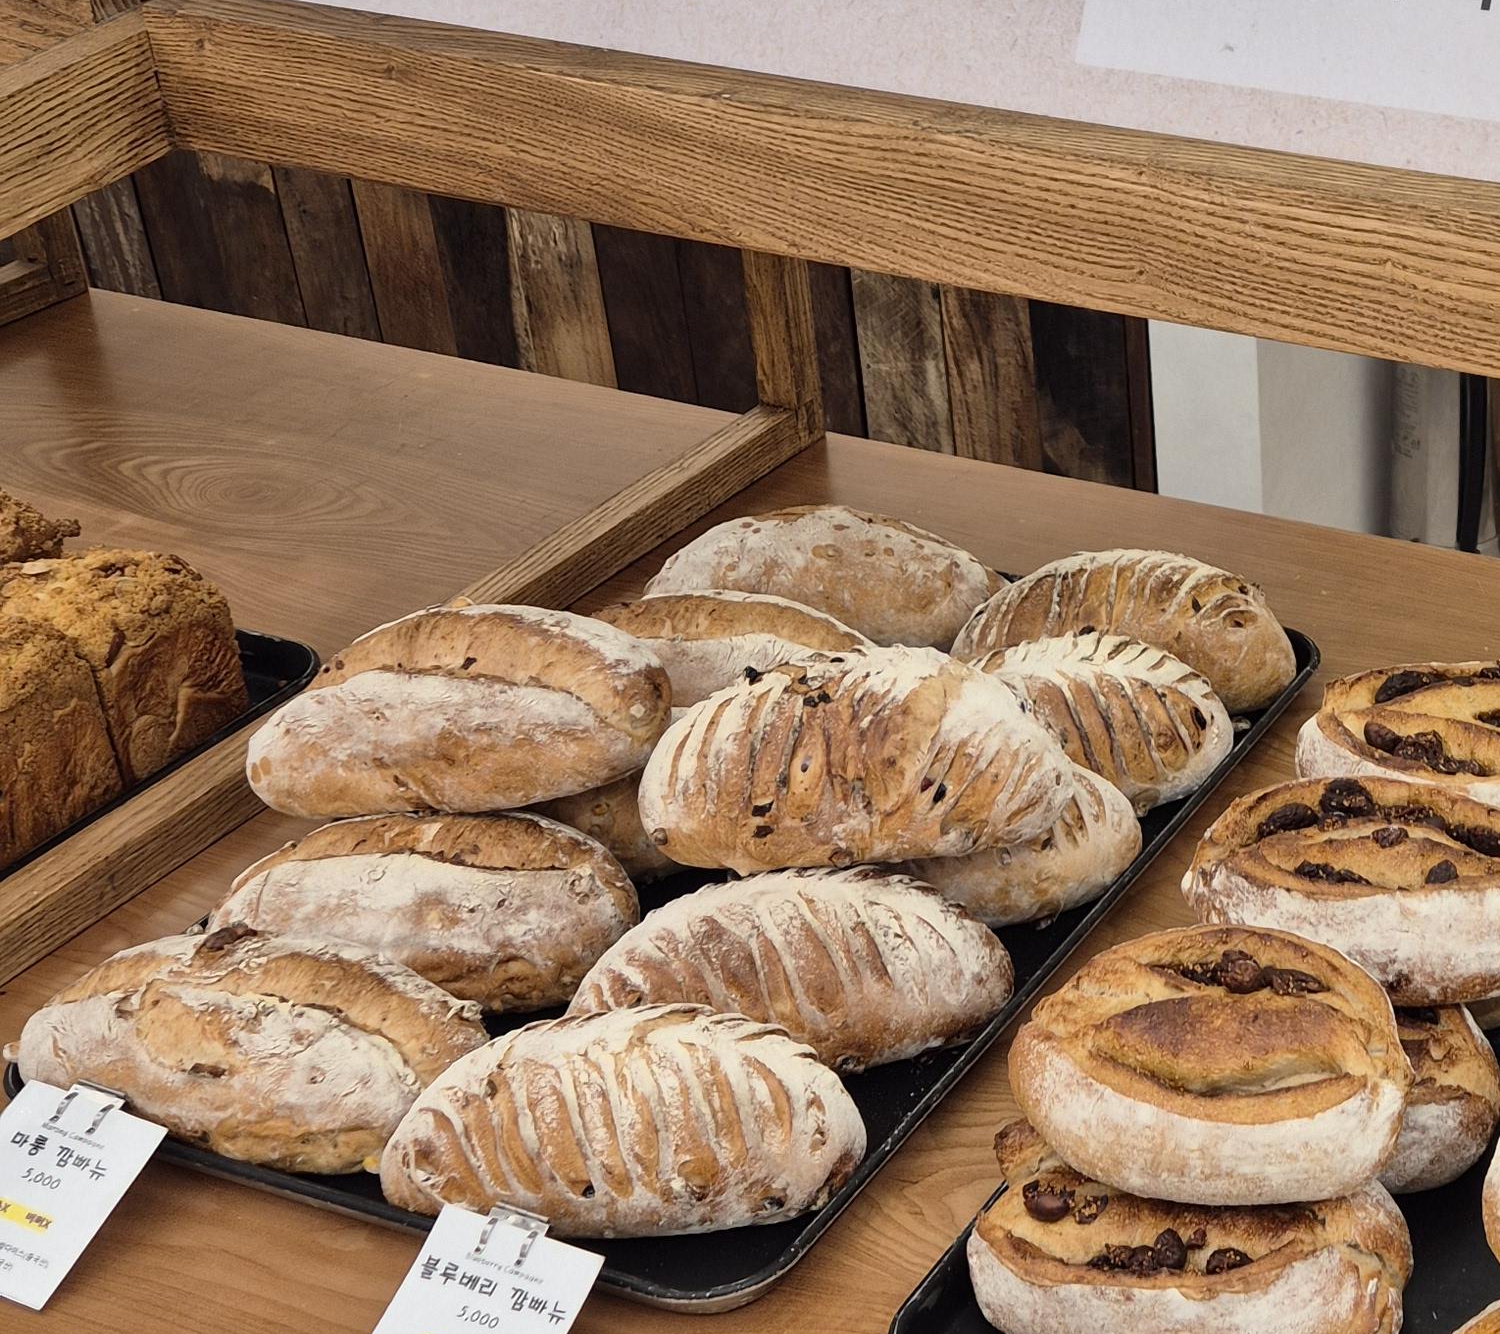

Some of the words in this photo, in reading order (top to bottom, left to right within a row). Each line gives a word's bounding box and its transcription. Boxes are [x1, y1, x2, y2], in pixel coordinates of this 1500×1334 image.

[11, 1132, 48, 1156] 마롱
[56, 1146, 106, 1180] 깜빠뉴
[22, 1168, 61, 1189] 5,000
[421, 1255, 497, 1296] 블루베리
[511, 1287, 565, 1324] 깜빠뉴
[457, 1306, 499, 1329] 5,000
